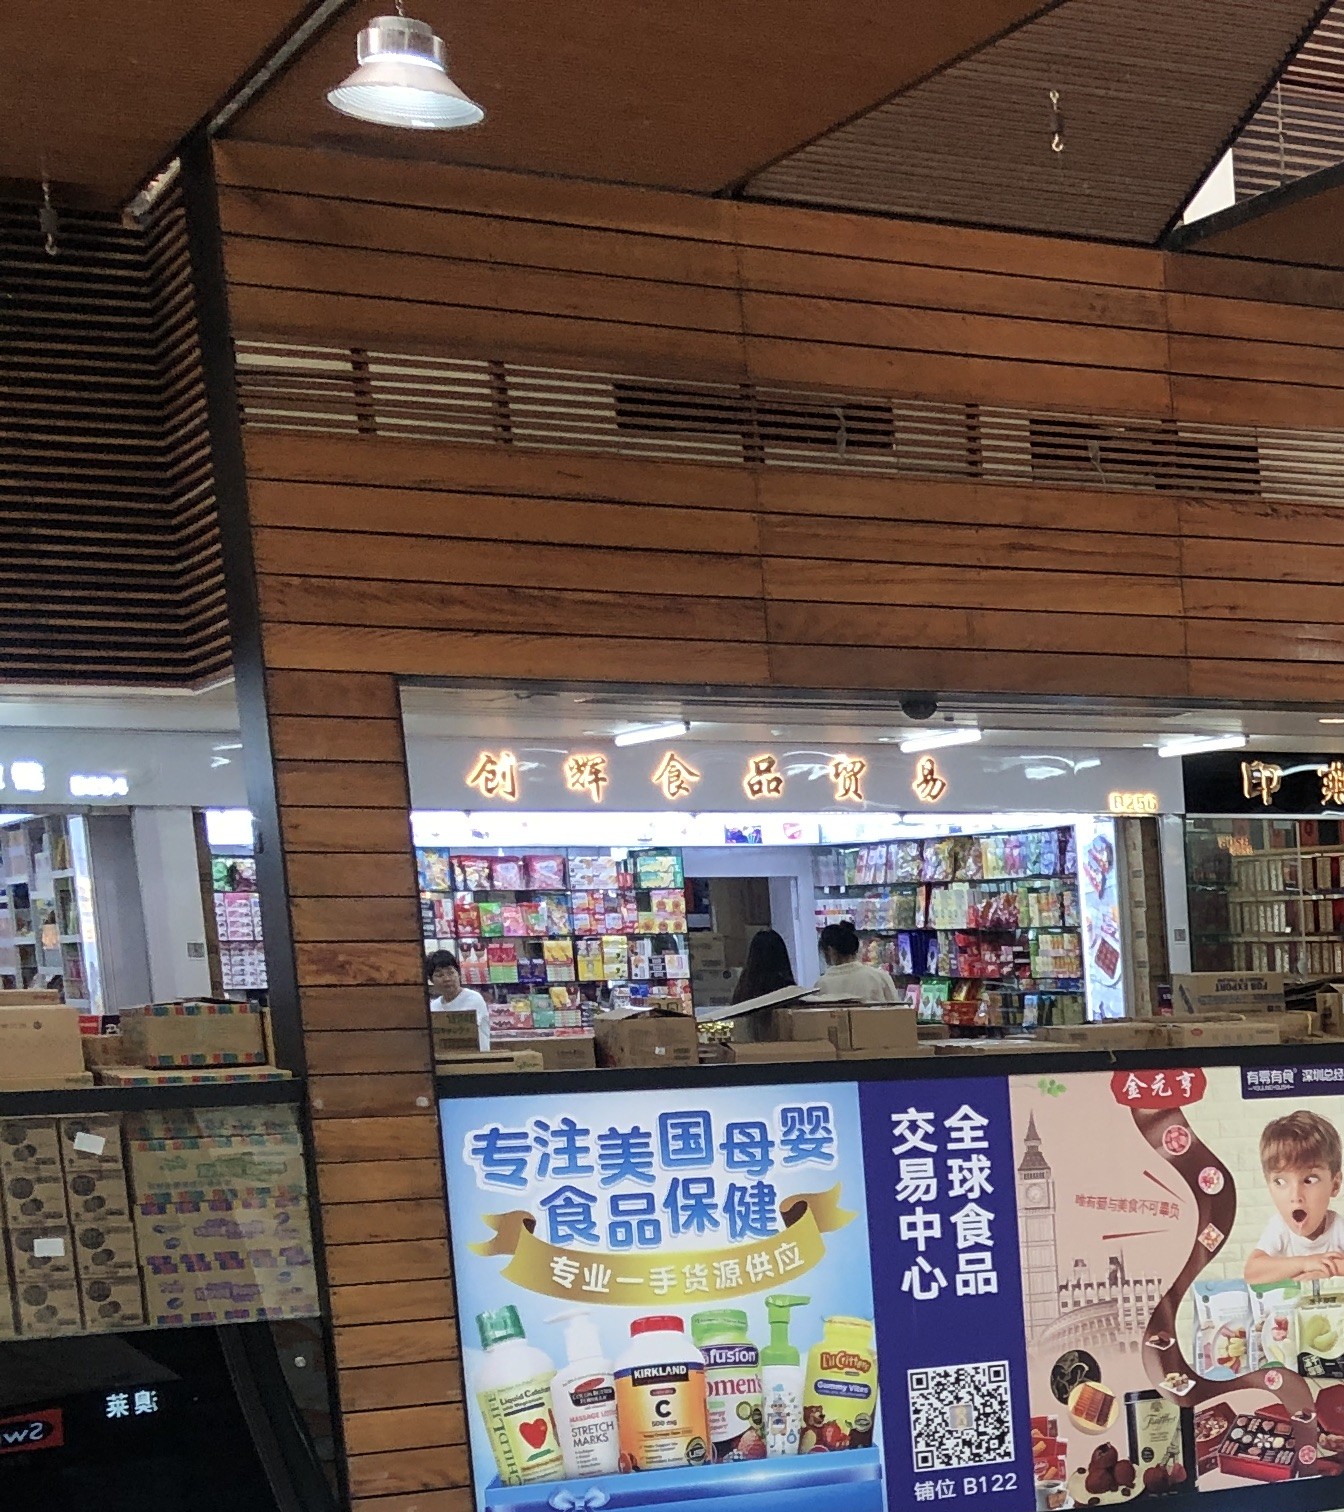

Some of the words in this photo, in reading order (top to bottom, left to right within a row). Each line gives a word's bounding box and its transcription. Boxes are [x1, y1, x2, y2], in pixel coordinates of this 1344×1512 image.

[466, 752, 949, 802] 创辉食品贸易
[1121, 1071, 1196, 1100] 金元亨
[470, 1105, 836, 1188] 专注美国母婴
[539, 1177, 780, 1249] 食品保健
[890, 1108, 949, 1301] 交易中心
[943, 1104, 999, 1297] 全球食品
[549, 1241, 806, 1296] 专业一手货源供应
[634, 1365, 687, 1379] KIRKLAND
[655, 1400, 672, 1418] C
[571, 1421, 615, 1438] STRETCH
[573, 1433, 609, 1448] MARKS
[914, 1477, 958, 1502] 铺位
[963, 1472, 1018, 1497] B122
